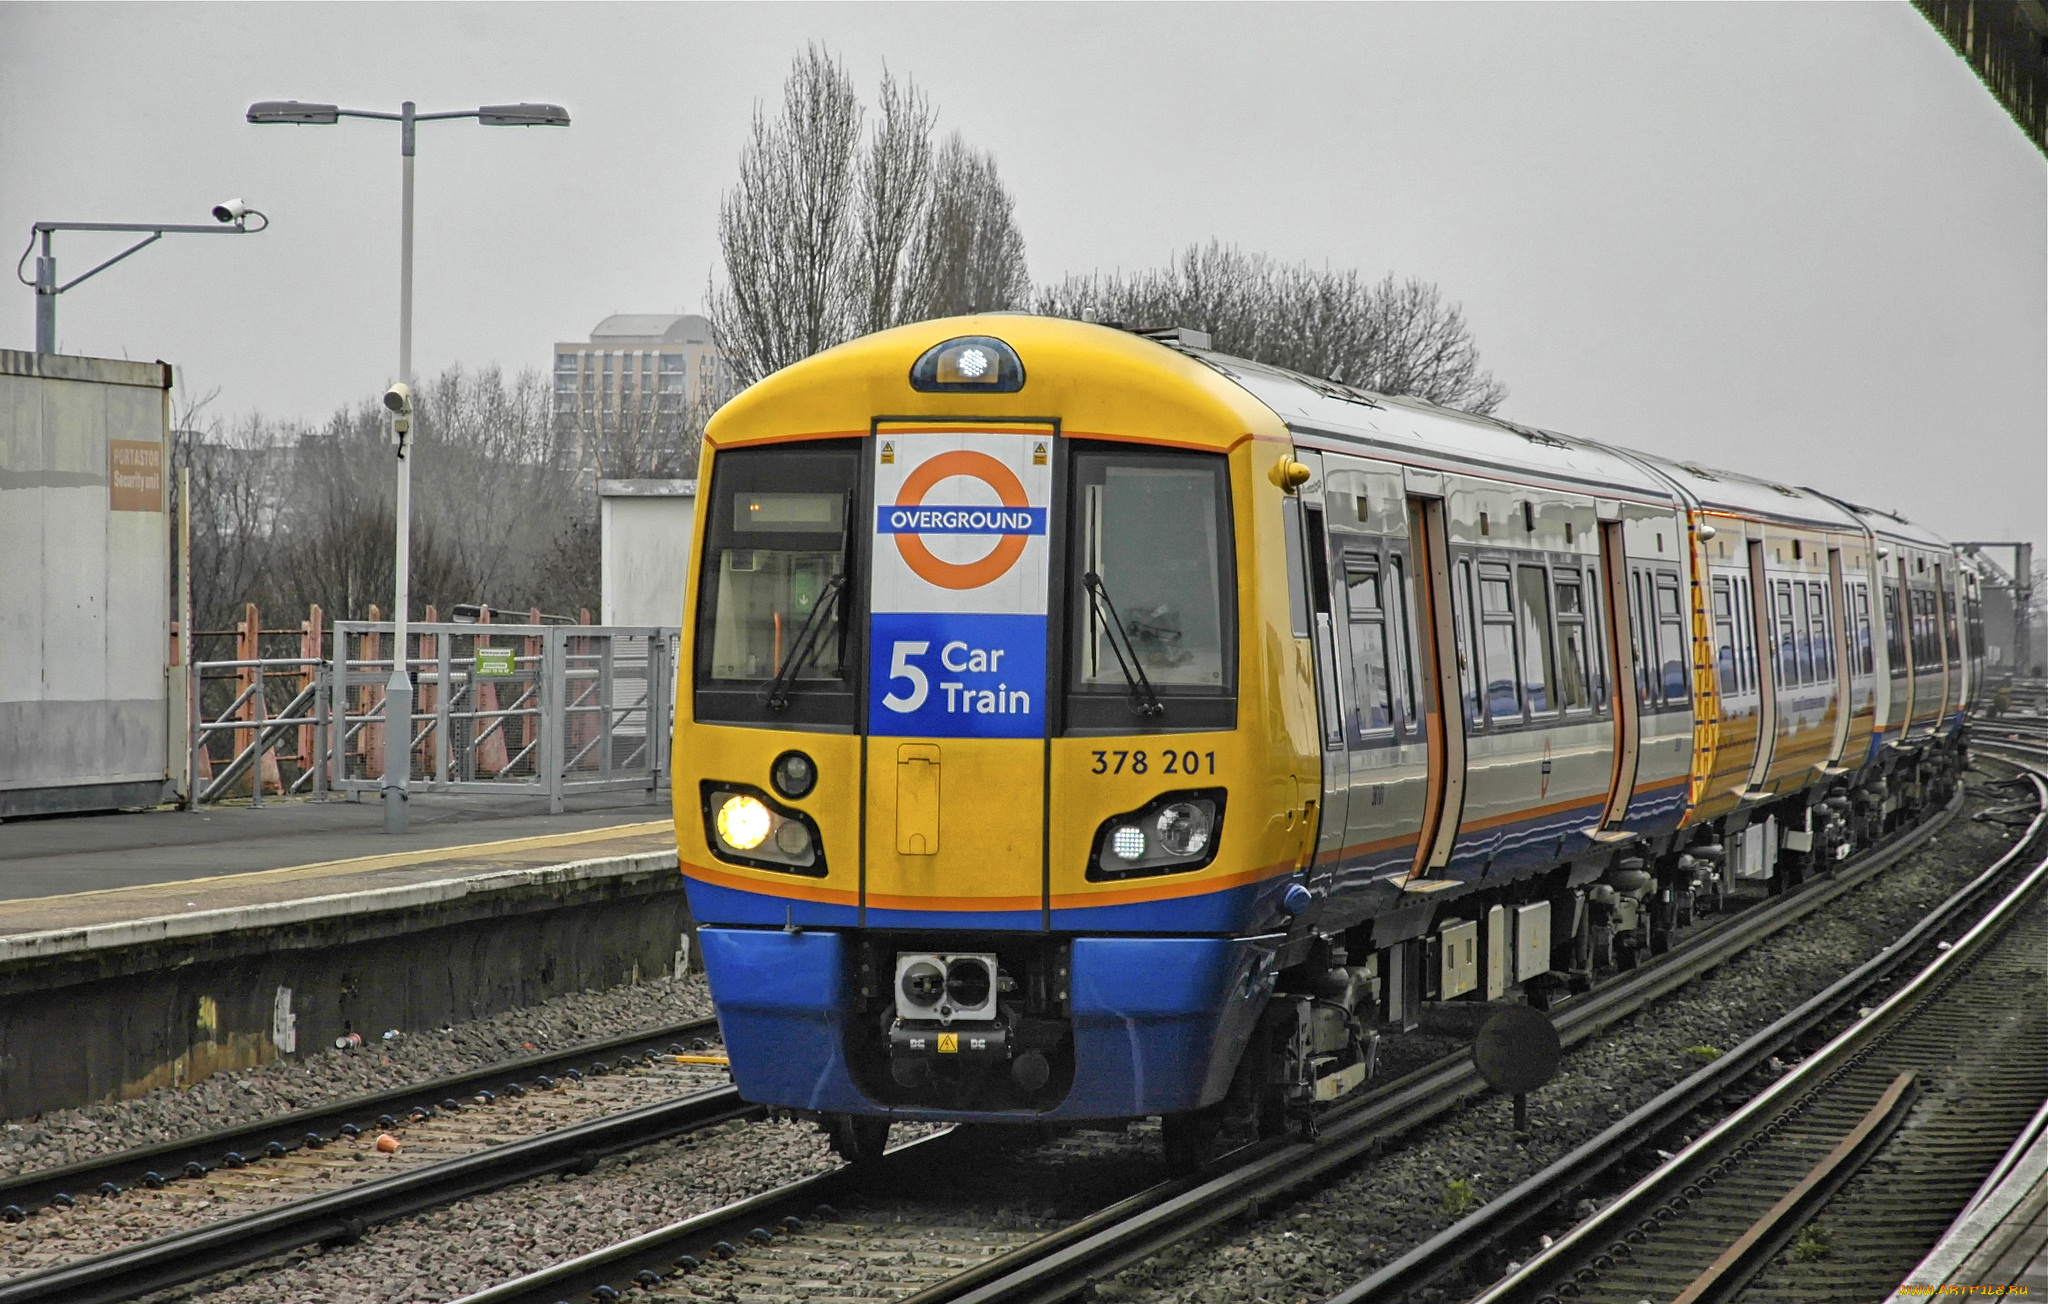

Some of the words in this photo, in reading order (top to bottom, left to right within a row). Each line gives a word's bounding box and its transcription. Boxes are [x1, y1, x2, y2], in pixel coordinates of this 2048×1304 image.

[113, 448, 160, 467] PORTASTOR
[113, 470, 144, 492] Security
[145, 472, 160, 489] unit
[890, 511, 1032, 529] OVERGROUND
[882, 641, 930, 713] 5
[941, 640, 1004, 673] Car
[940, 682, 1030, 714] Train
[1091, 750, 1148, 775] 378
[1162, 750, 1214, 775] 201
